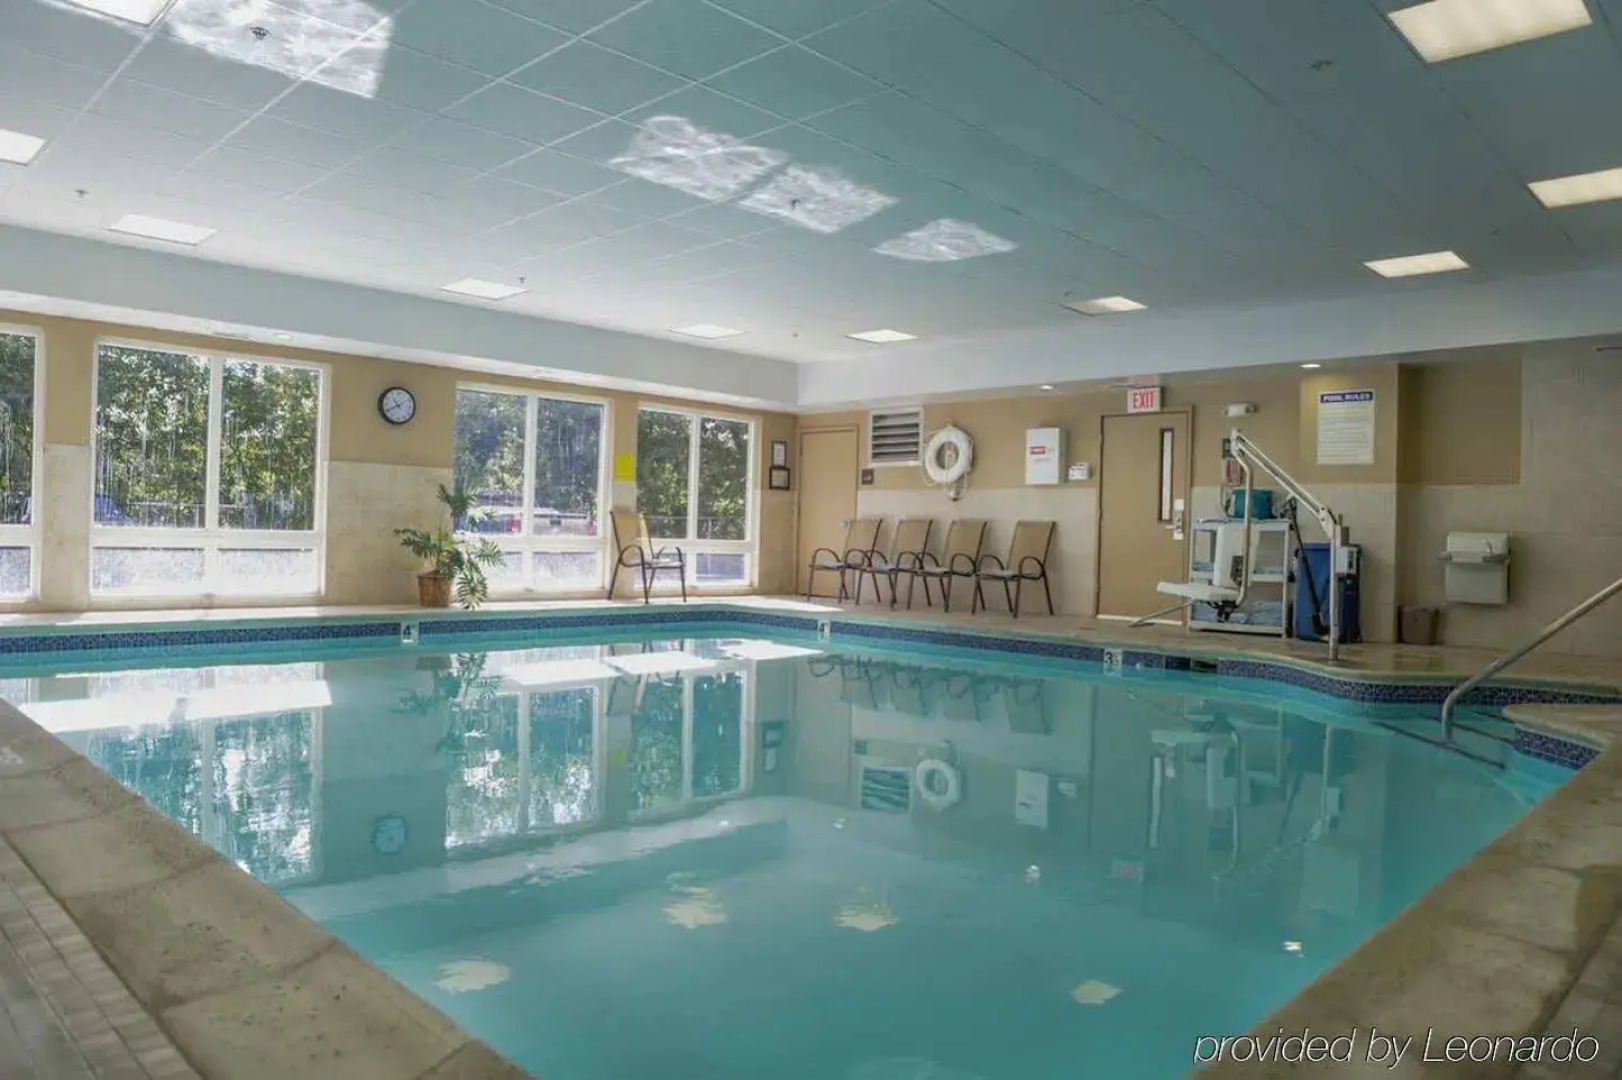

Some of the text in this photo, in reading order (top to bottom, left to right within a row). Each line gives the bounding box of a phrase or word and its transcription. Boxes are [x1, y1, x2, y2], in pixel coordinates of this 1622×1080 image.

[1132, 391, 1154, 409] EXIT
[1323, 392, 1371, 402] POOL RULES
